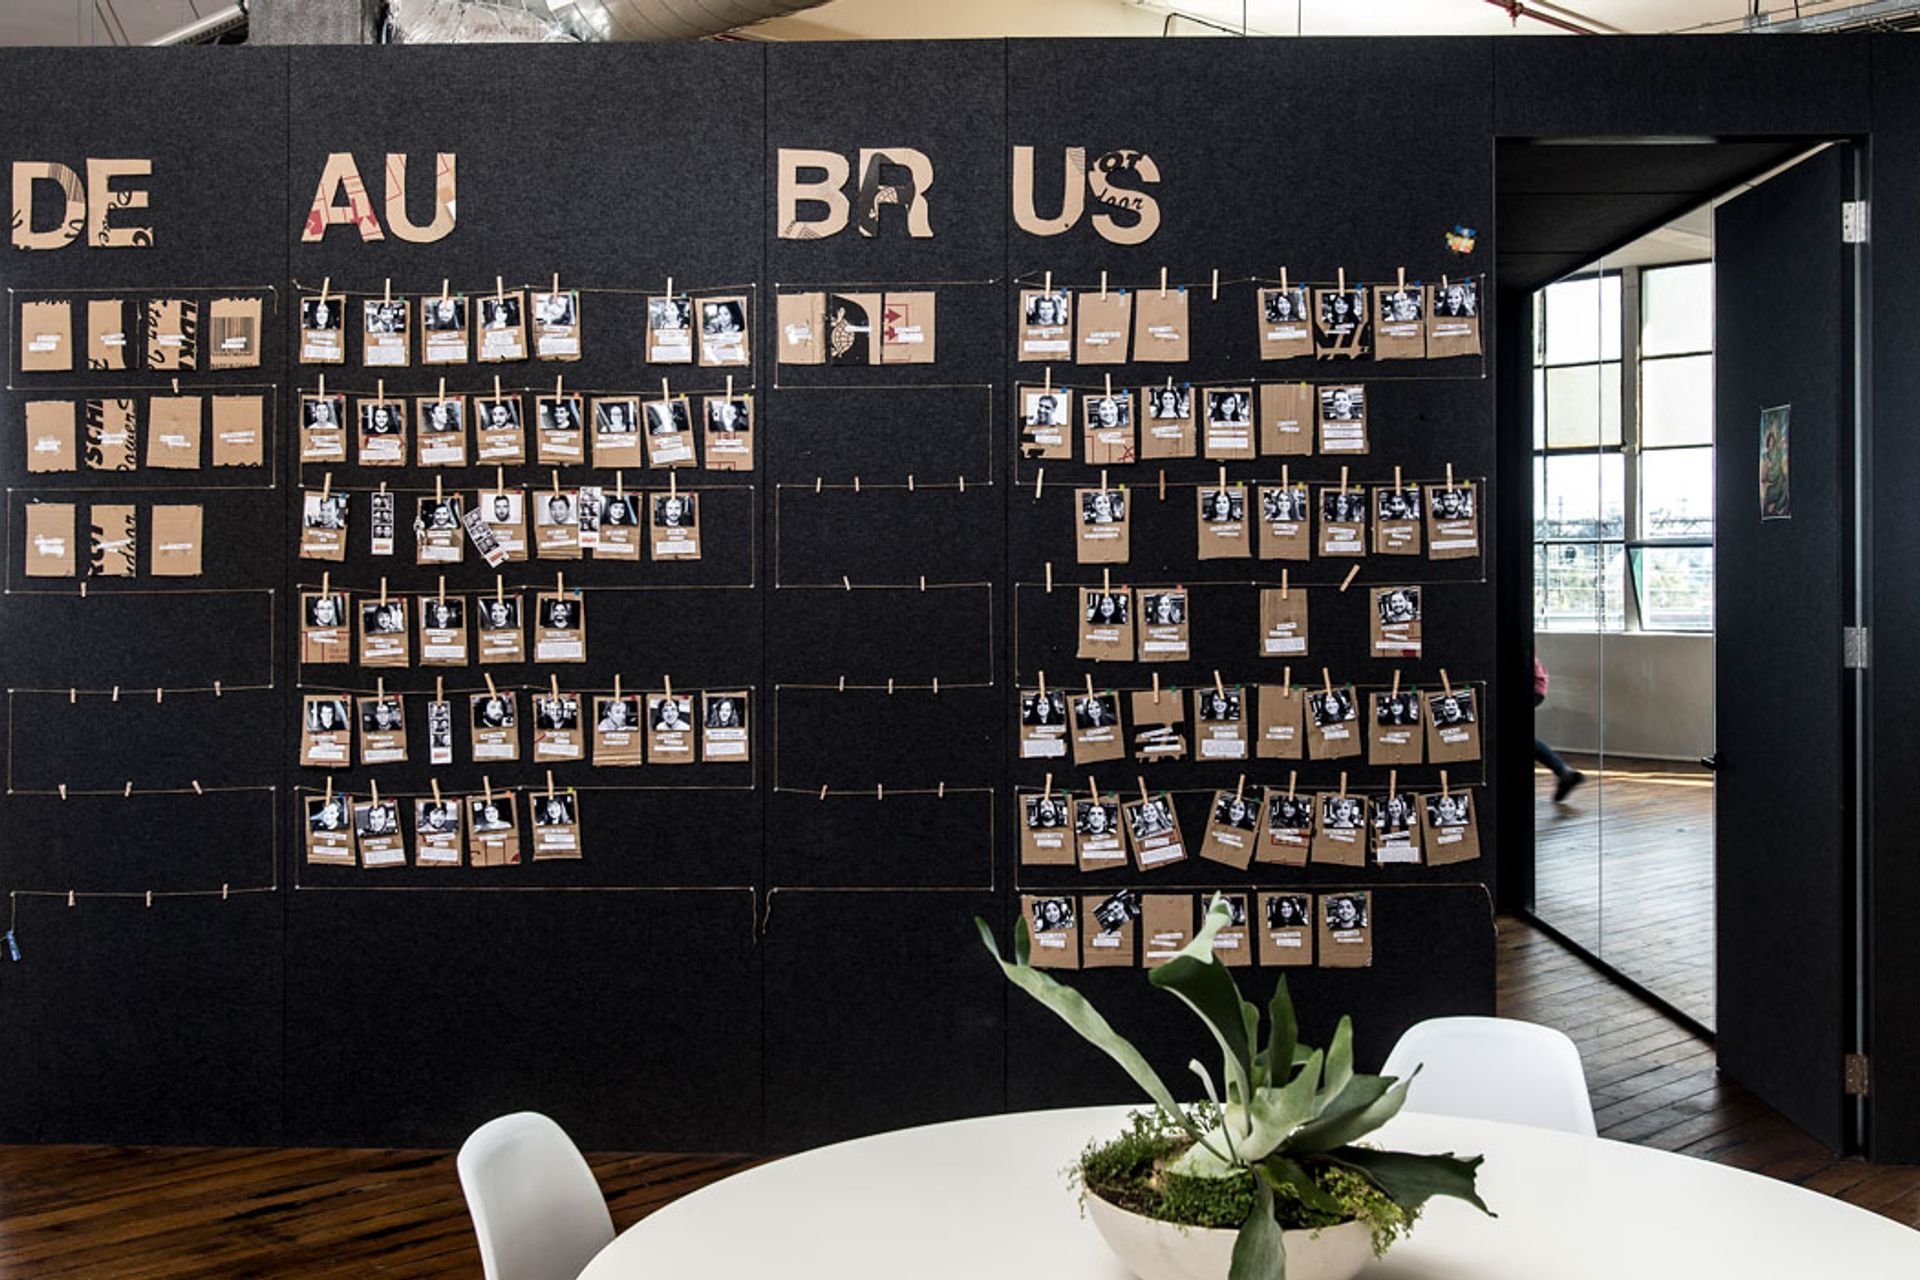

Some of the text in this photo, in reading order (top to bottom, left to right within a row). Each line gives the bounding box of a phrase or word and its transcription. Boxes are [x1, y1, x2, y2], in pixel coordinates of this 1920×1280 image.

[12, 158, 153, 249] DE
[301, 152, 456, 242] AU
[777, 148, 934, 239] BR
[1013, 146, 1161, 245] US
